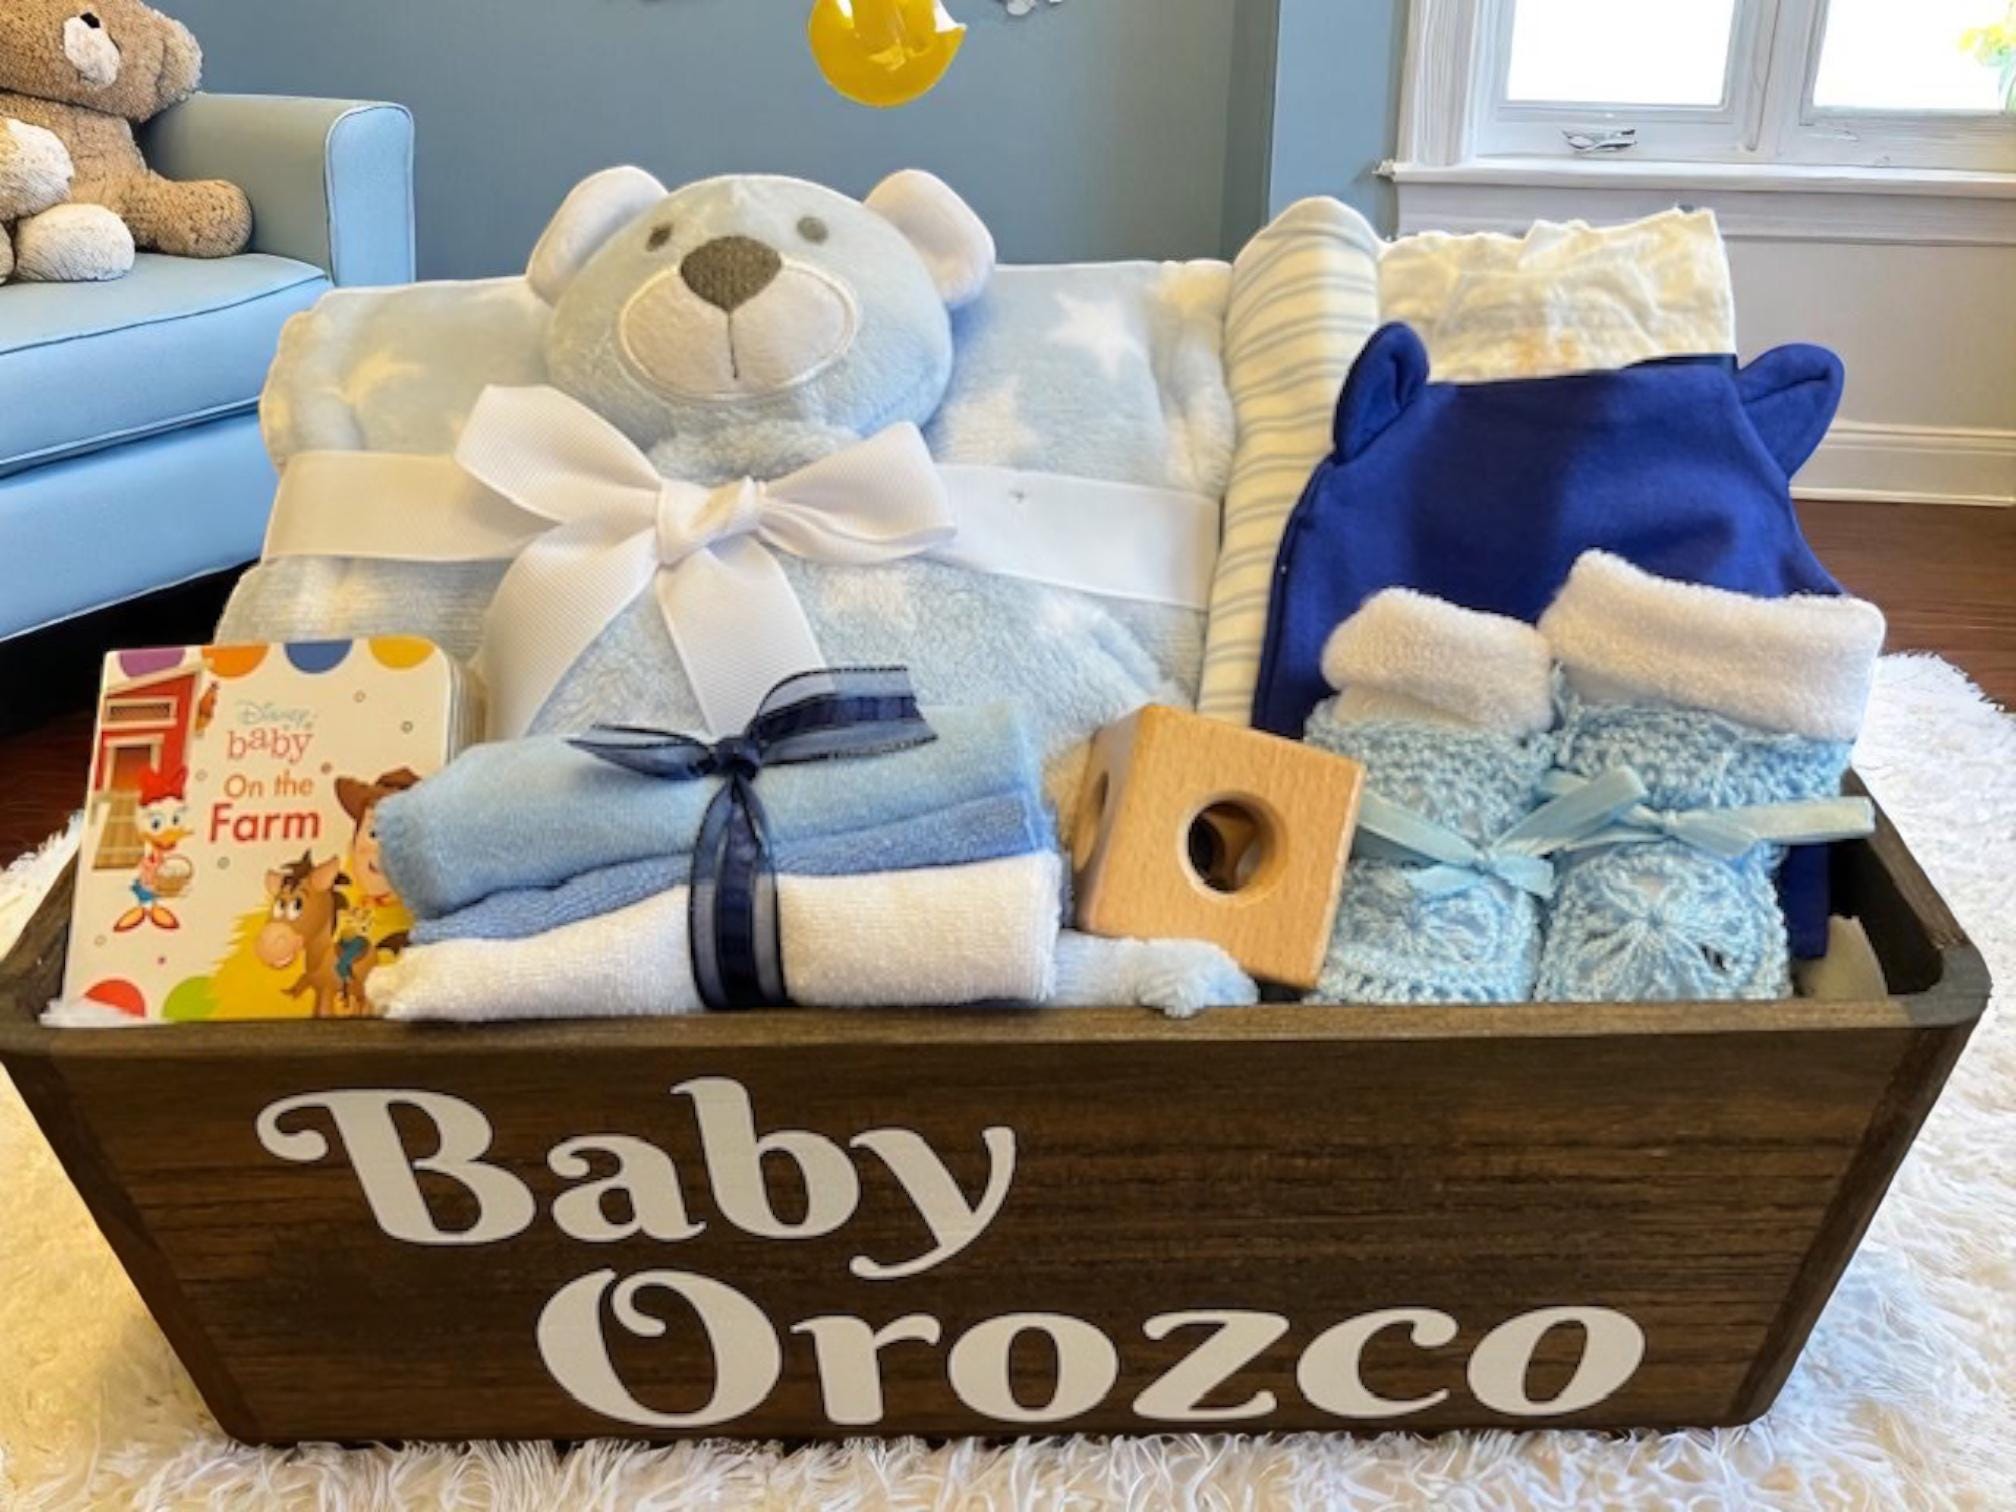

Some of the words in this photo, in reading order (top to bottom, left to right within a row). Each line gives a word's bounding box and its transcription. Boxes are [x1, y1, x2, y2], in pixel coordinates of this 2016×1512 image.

[227, 728, 313, 763] baby
[224, 774, 264, 798] On
[274, 770, 314, 797] the
[209, 803, 320, 842] Farm
[257, 1077, 1016, 1278] Baby
[536, 1269, 1645, 1427] Orozco
